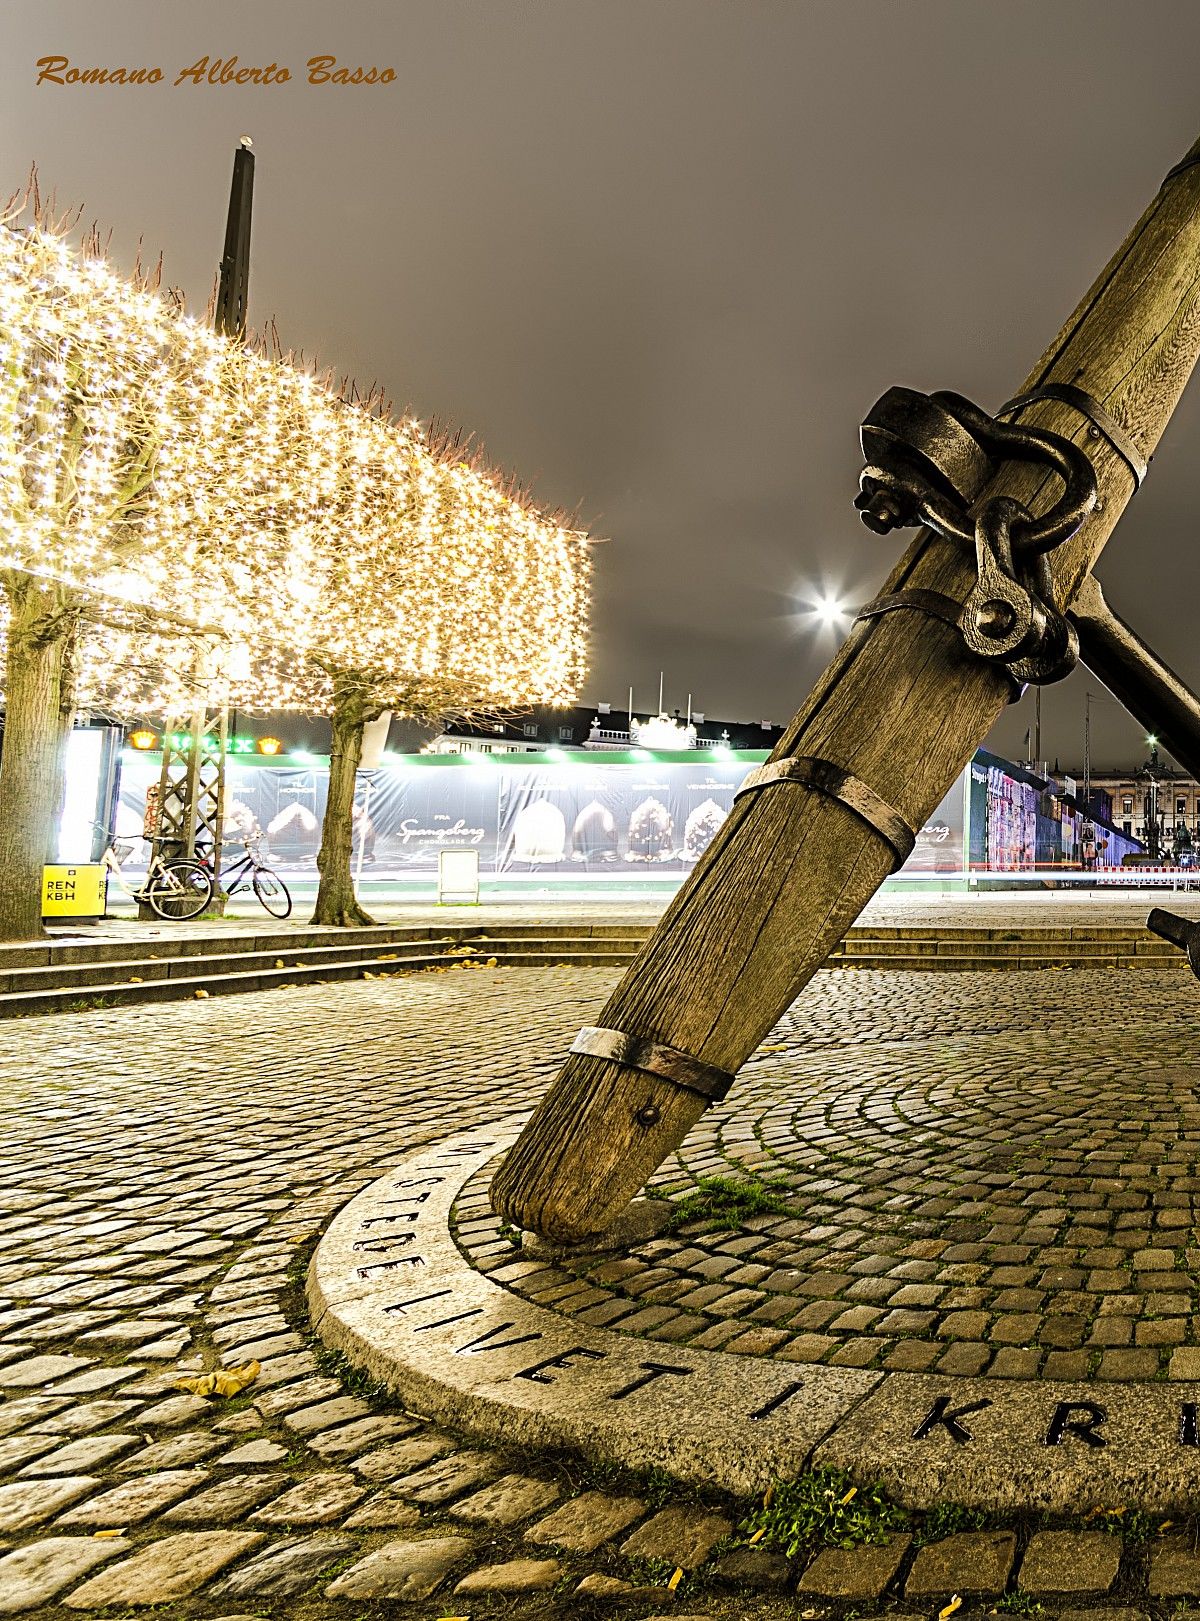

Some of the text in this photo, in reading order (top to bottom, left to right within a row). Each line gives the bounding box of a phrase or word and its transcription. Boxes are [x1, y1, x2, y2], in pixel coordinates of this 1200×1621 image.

[47, 881, 76, 889] REN
[46, 892, 75, 901] KBH
[382, 1289, 694, 1400] LIVET
[750, 1381, 804, 1421] I
